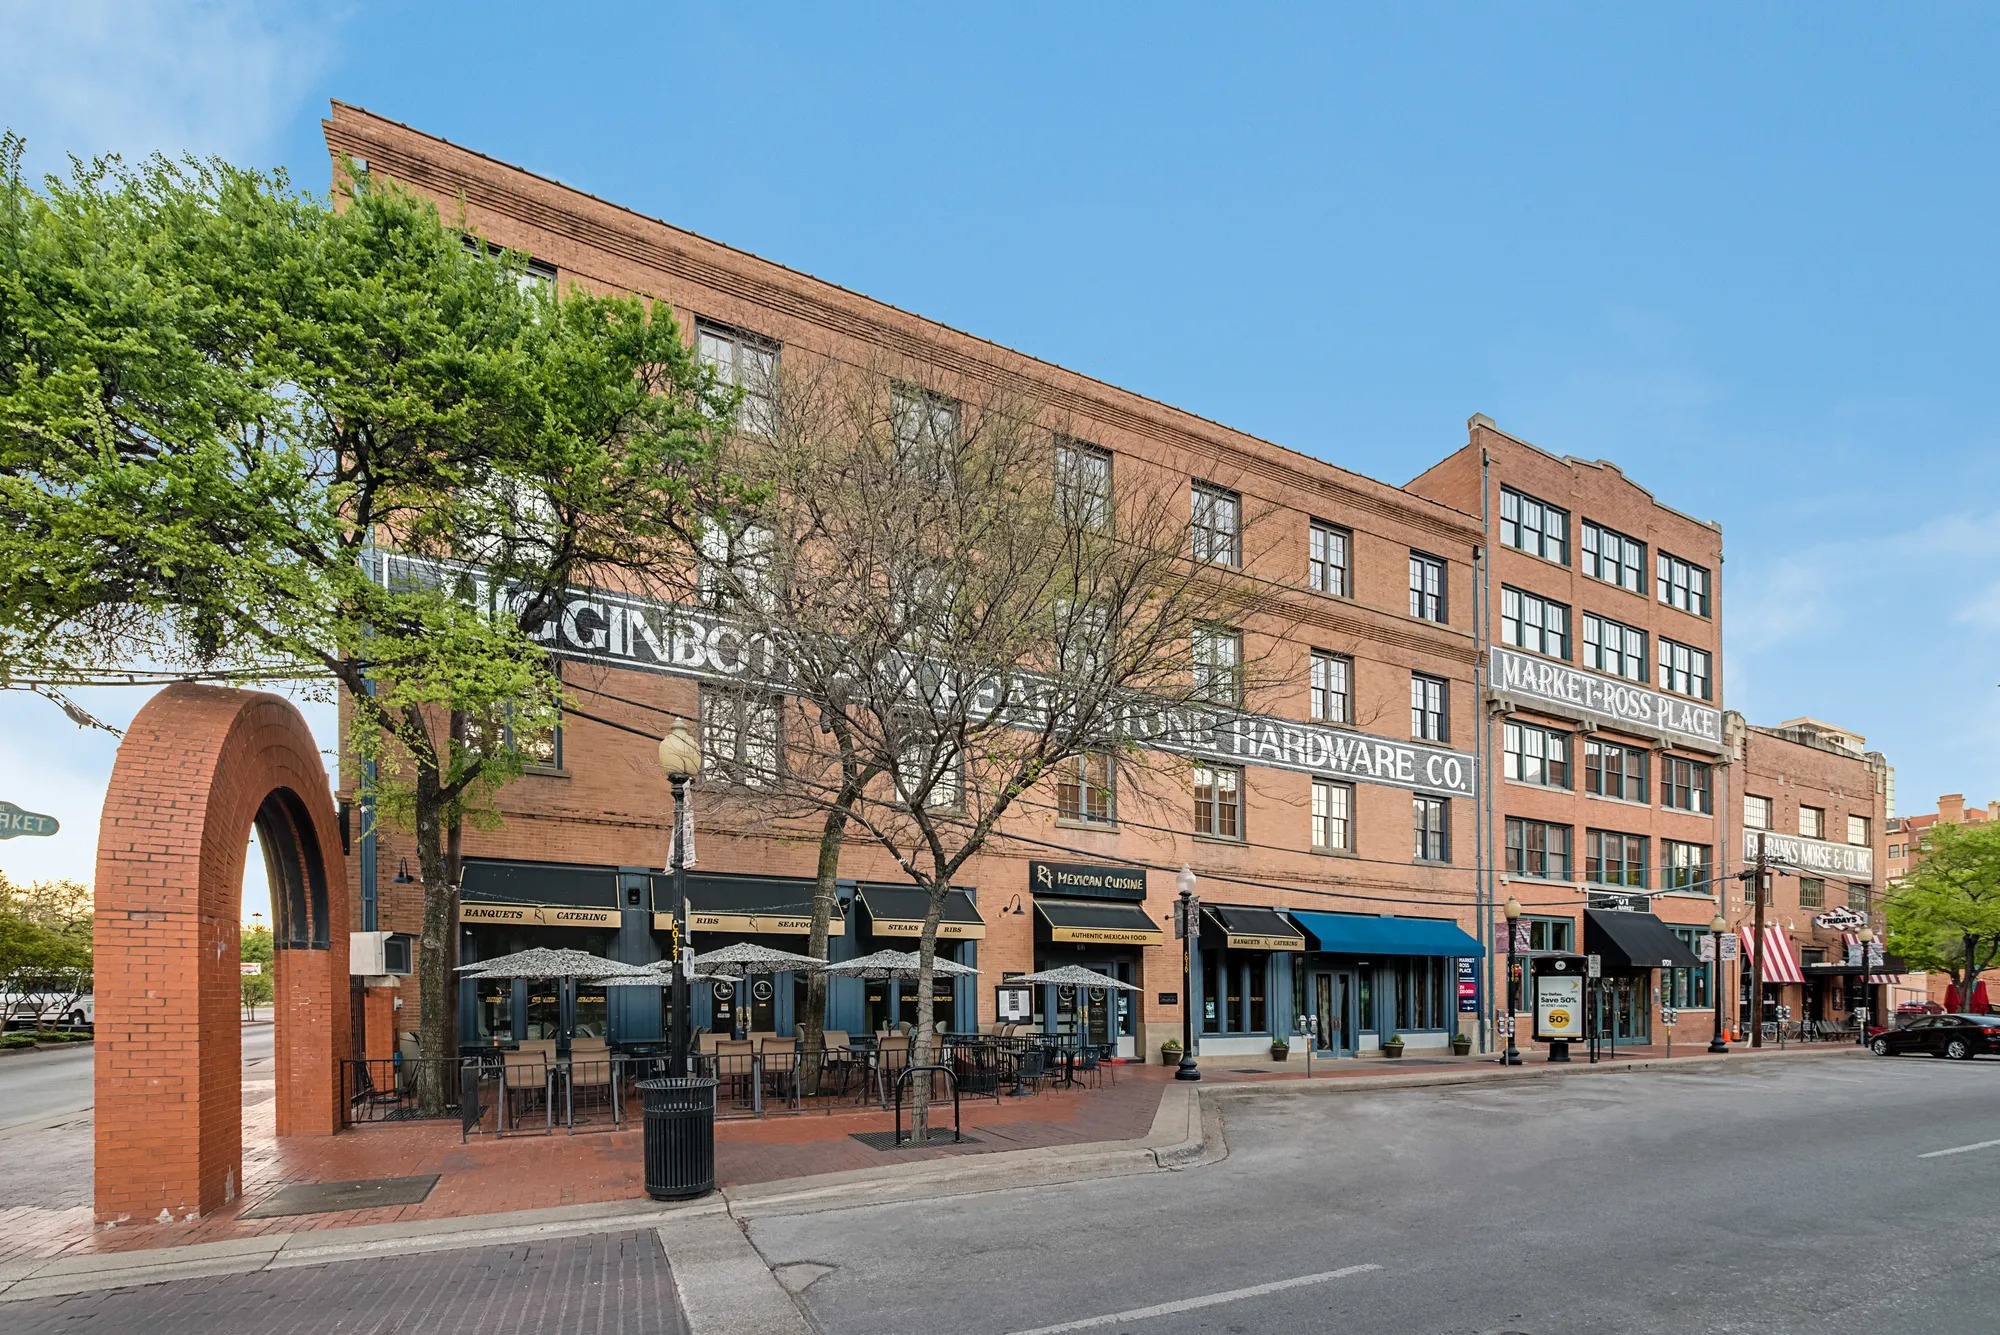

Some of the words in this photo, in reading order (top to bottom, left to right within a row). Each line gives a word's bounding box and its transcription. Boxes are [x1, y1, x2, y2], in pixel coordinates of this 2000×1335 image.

[1657, 697, 1716, 739] PLACE
[1233, 720, 1415, 782] HARDWARE
[1426, 754, 1466, 791] CO.
[1746, 834, 1798, 863] FABANKS
[1800, 843, 1832, 869] MORSE
[1057, 871, 1102, 888] MEXICAN
[1104, 875, 1143, 890] CUISINE
[464, 909, 523, 919] BANQUETS
[556, 911, 607, 921] CATERING
[696, 917, 719, 925] RIBS
[777, 920, 812, 928] SEAFOO
[1071, 932, 1103, 940] AUTHENTIC
[1549, 1015, 1569, 1023] 50%
